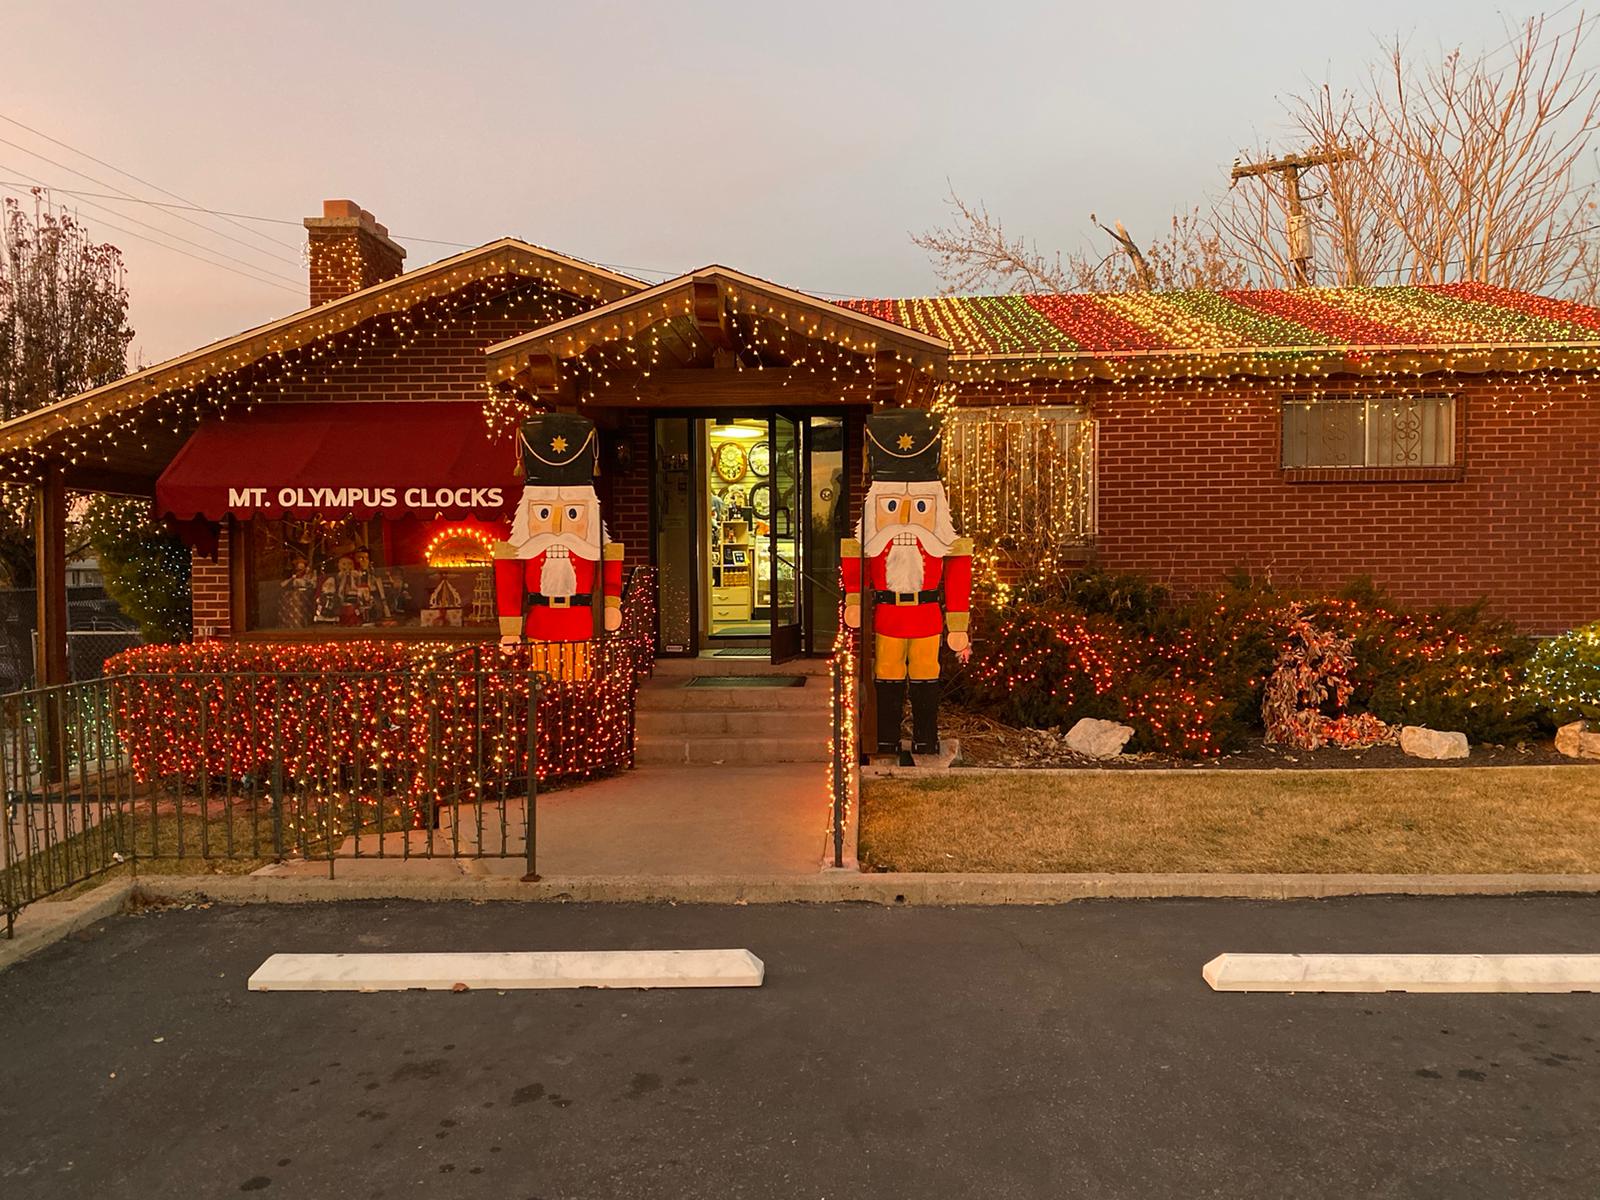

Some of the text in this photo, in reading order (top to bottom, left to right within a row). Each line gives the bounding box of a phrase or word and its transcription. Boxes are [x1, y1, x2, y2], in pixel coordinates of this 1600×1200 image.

[228, 488, 503, 507] MT. OLYMPUS CLOCKS
